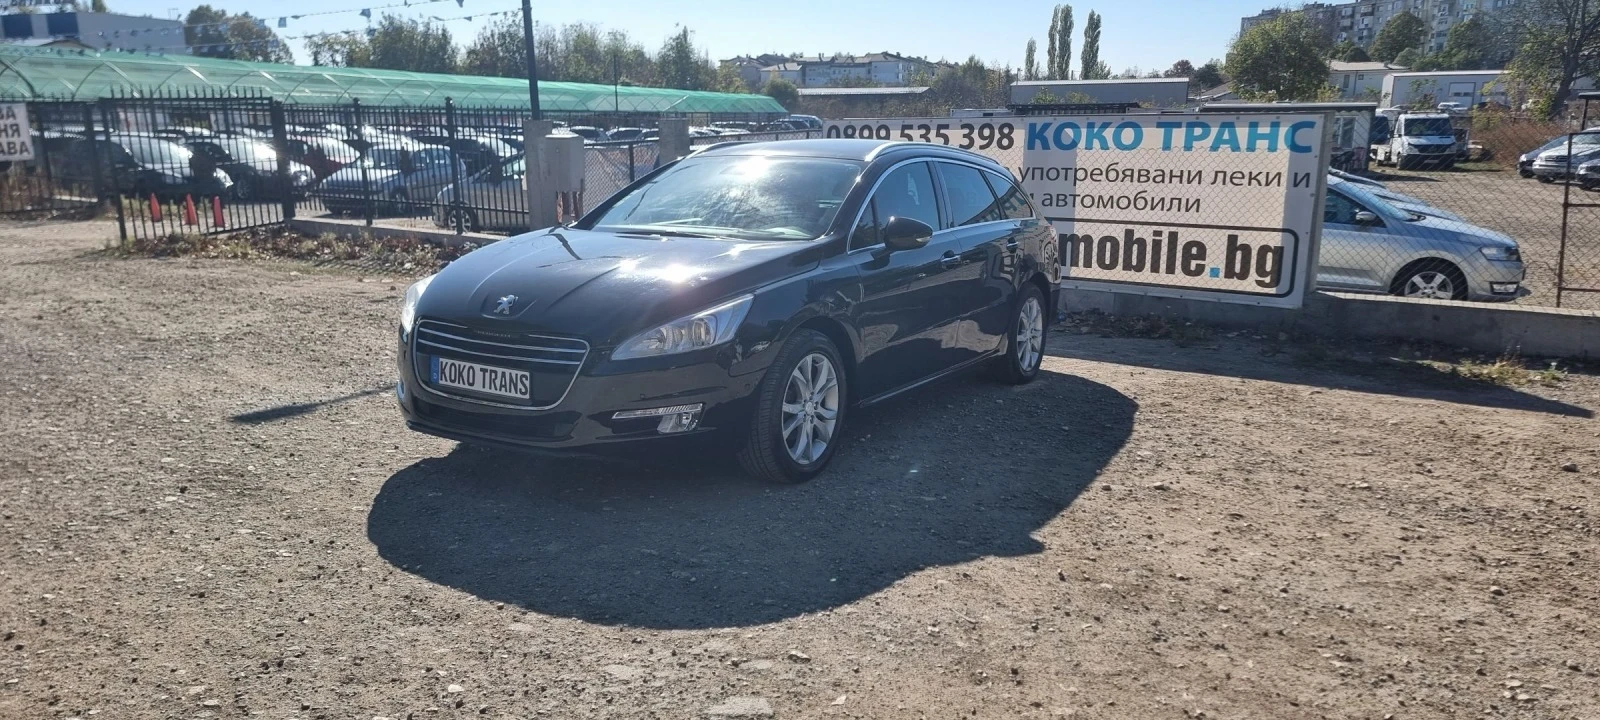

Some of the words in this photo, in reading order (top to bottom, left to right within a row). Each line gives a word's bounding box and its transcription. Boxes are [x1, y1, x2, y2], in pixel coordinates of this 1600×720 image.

[899, 123, 950, 146] 535
[958, 122, 1015, 151] 398
[1027, 121, 1144, 151] КОКО
[1156, 120, 1317, 153] ТРАНС
[1017, 162, 1203, 186] употребявани
[1210, 170, 1282, 187] леки
[1292, 172, 1311, 188] и
[1041, 190, 1201, 213] автомобили
[1058, 228, 1285, 289] mobile.bg
[440, 360, 475, 387] KOKO
[479, 367, 529, 396] TRANS
